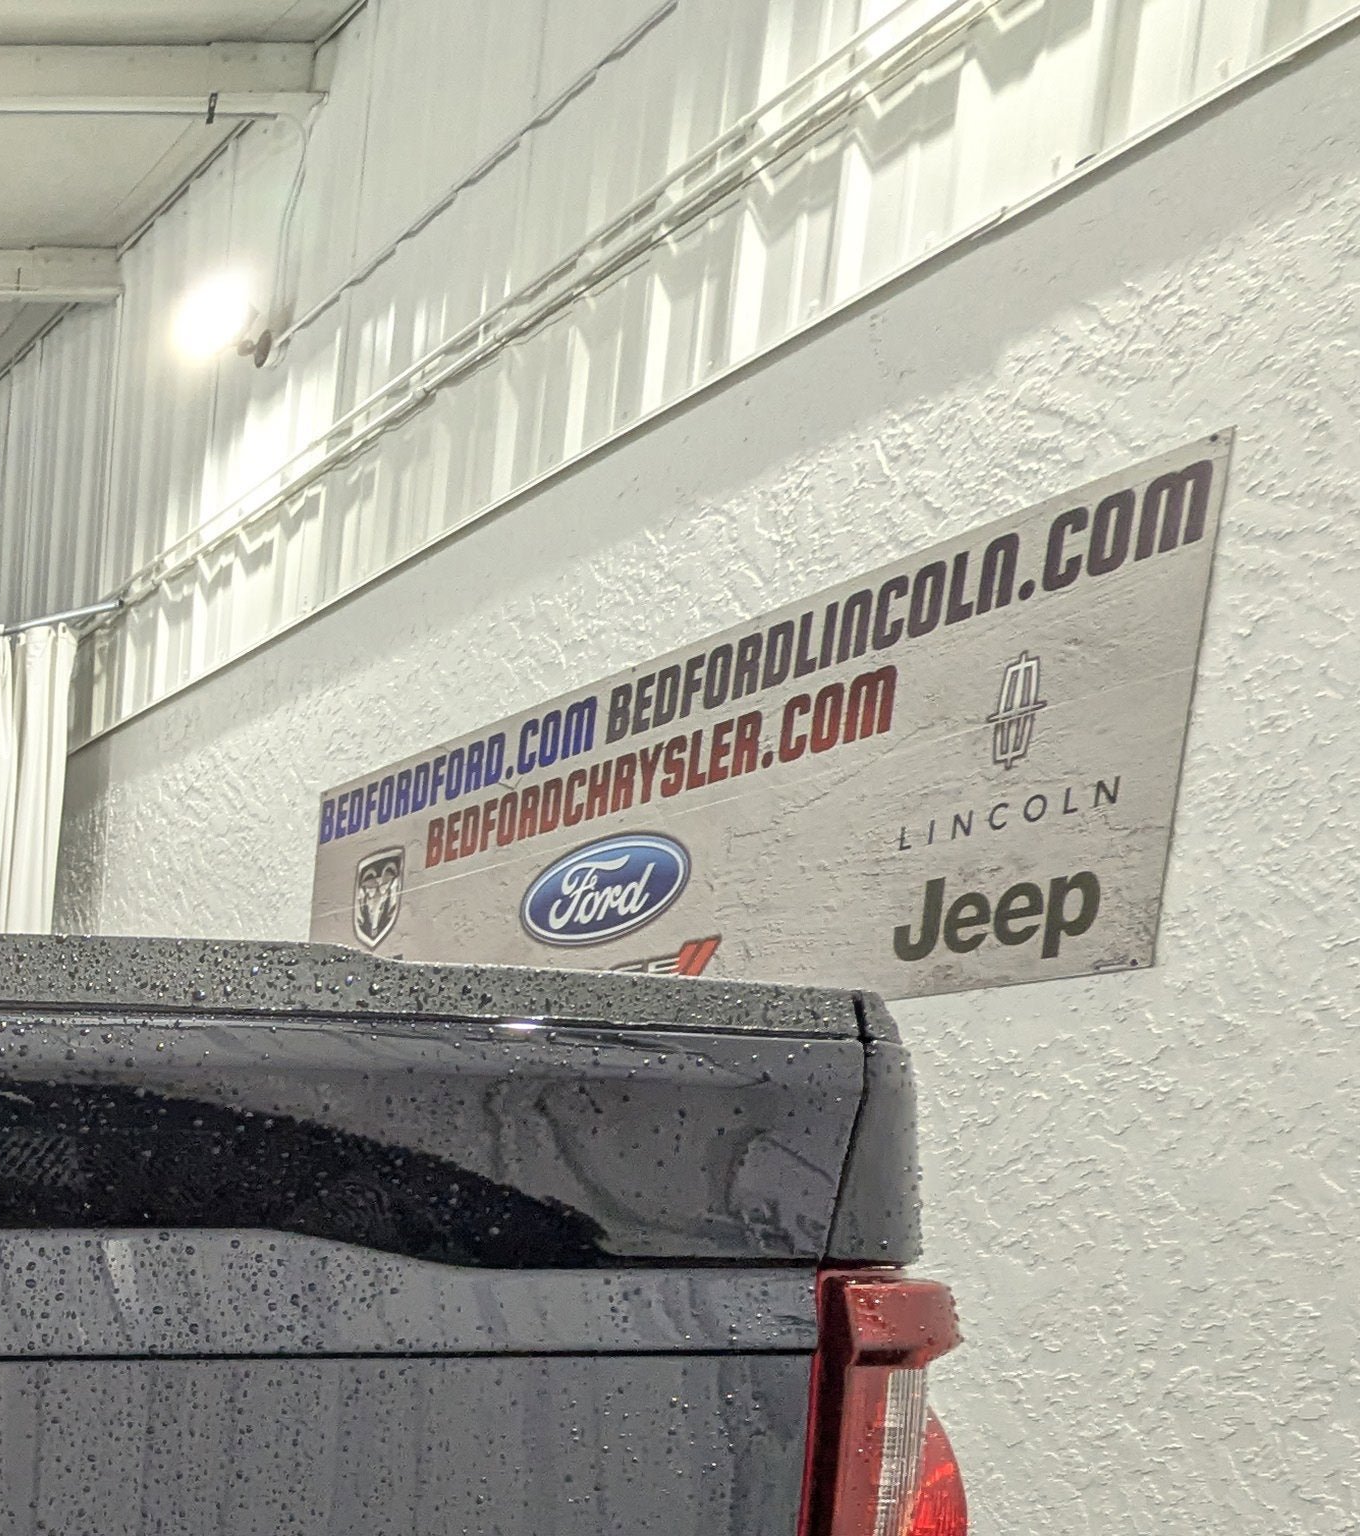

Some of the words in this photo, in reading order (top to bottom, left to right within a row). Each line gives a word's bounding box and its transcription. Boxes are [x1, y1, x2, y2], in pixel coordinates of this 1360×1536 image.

[319, 696, 597, 845] BEDFORDFORD.COM
[605, 460, 1213, 745] BEDFORDLINCOLN.COM
[425, 665, 897, 869] BEDFORDCHRYSLER.COM
[898, 775, 1121, 851] LINCOLN
[548, 854, 657, 929] Ford
[893, 870, 1101, 962] Jeep
